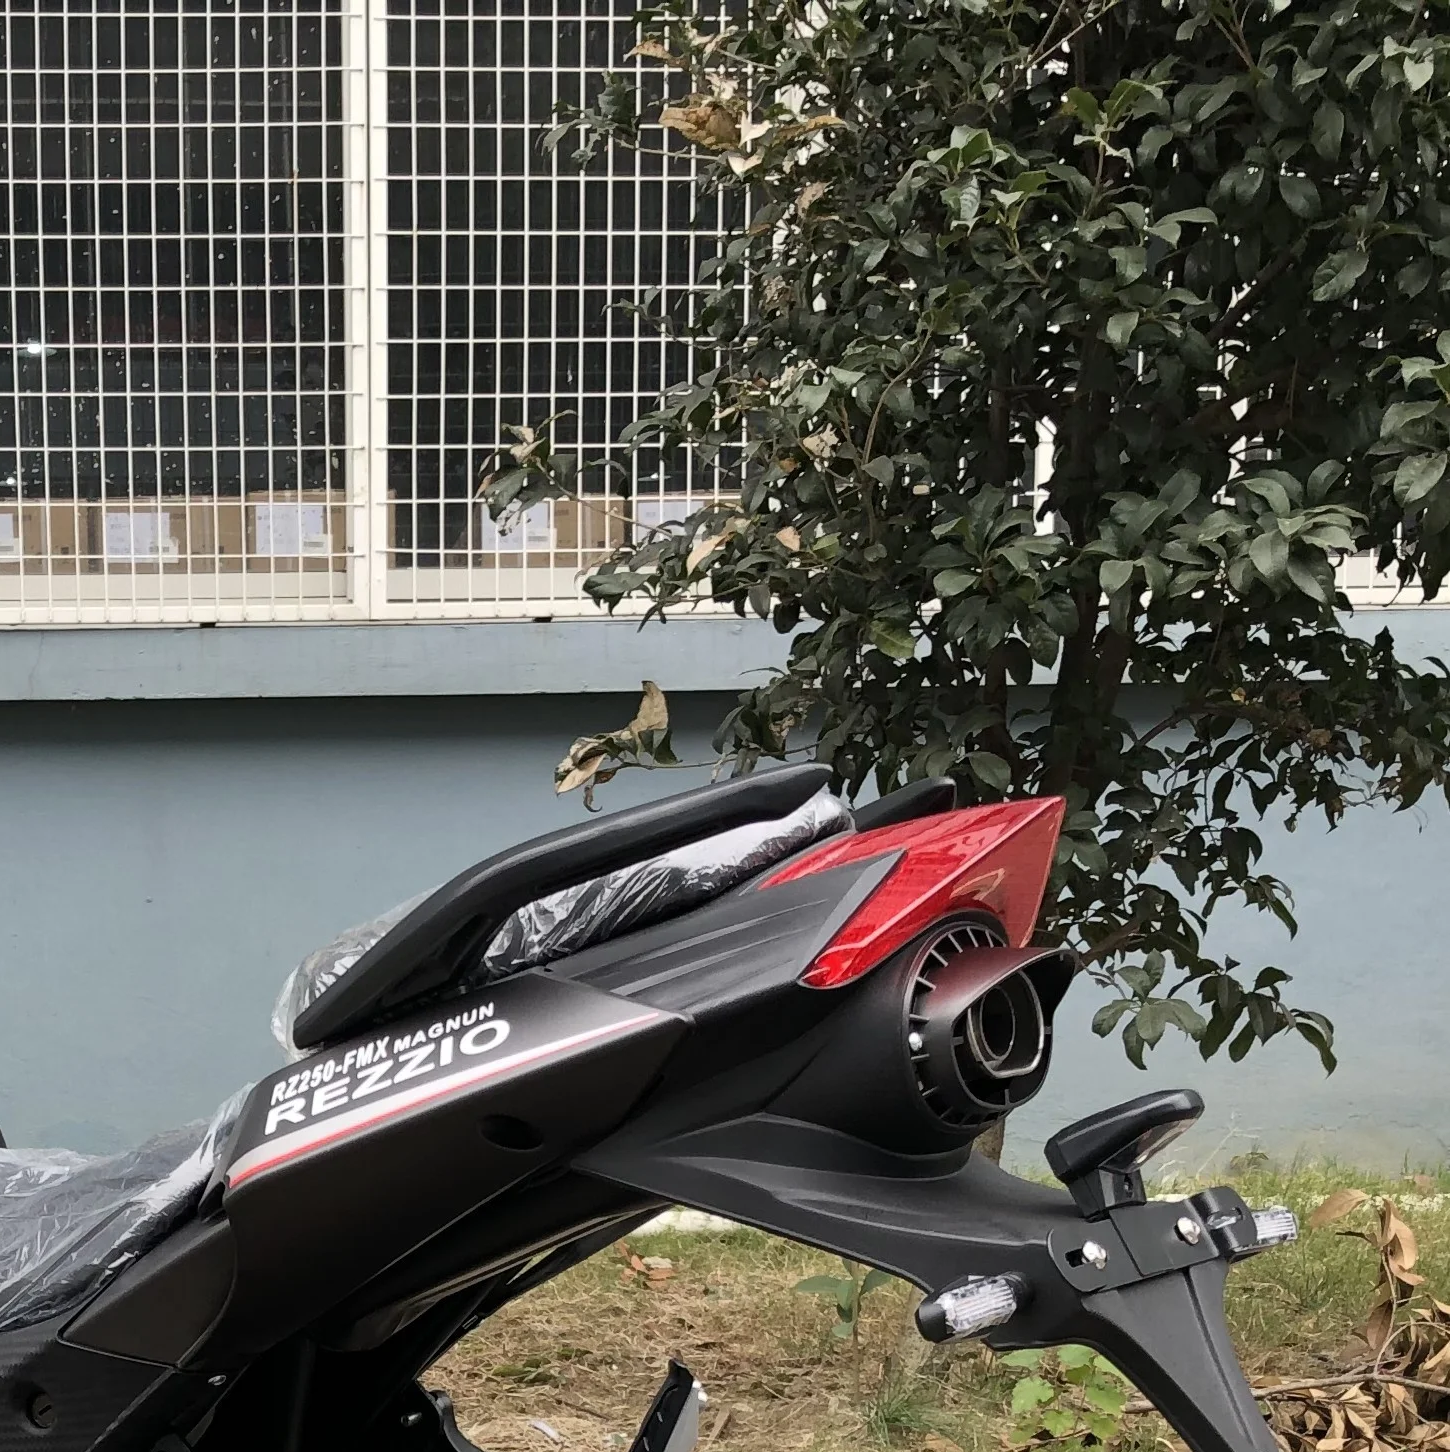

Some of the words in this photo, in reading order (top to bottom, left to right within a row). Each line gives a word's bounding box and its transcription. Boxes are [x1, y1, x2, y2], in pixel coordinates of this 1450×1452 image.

[263, 1018, 511, 1136] REZZIO
[270, 1035, 390, 1105] RZ250-FMX
[393, 1001, 495, 1054] MAGNUN
